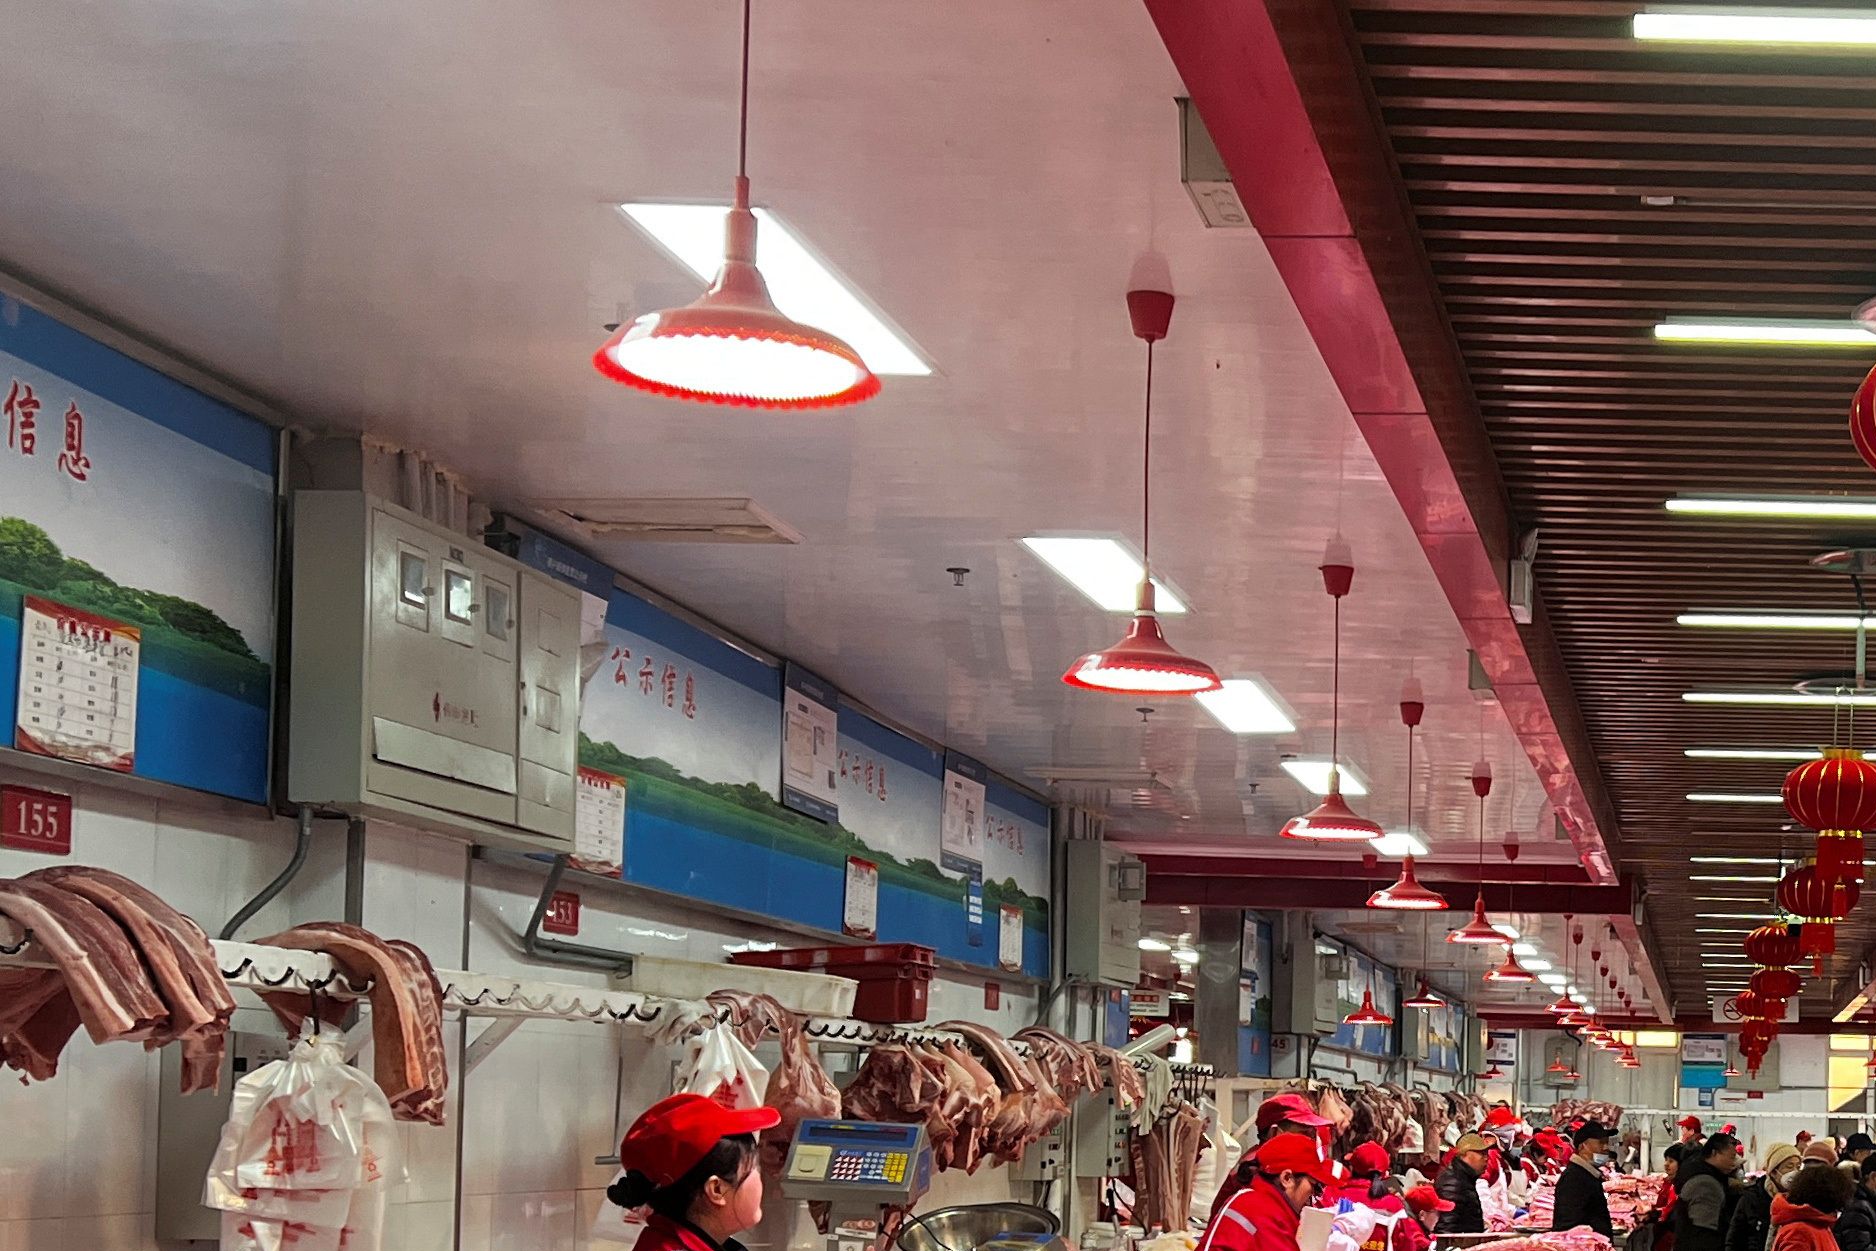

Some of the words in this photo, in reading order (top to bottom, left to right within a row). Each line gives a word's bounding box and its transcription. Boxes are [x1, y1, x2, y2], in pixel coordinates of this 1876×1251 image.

[4, 379, 91, 481] 信息
[612, 647, 697, 720] 公示信息
[838, 749, 888, 801] 公示信息
[17, 800, 58, 838] 155
